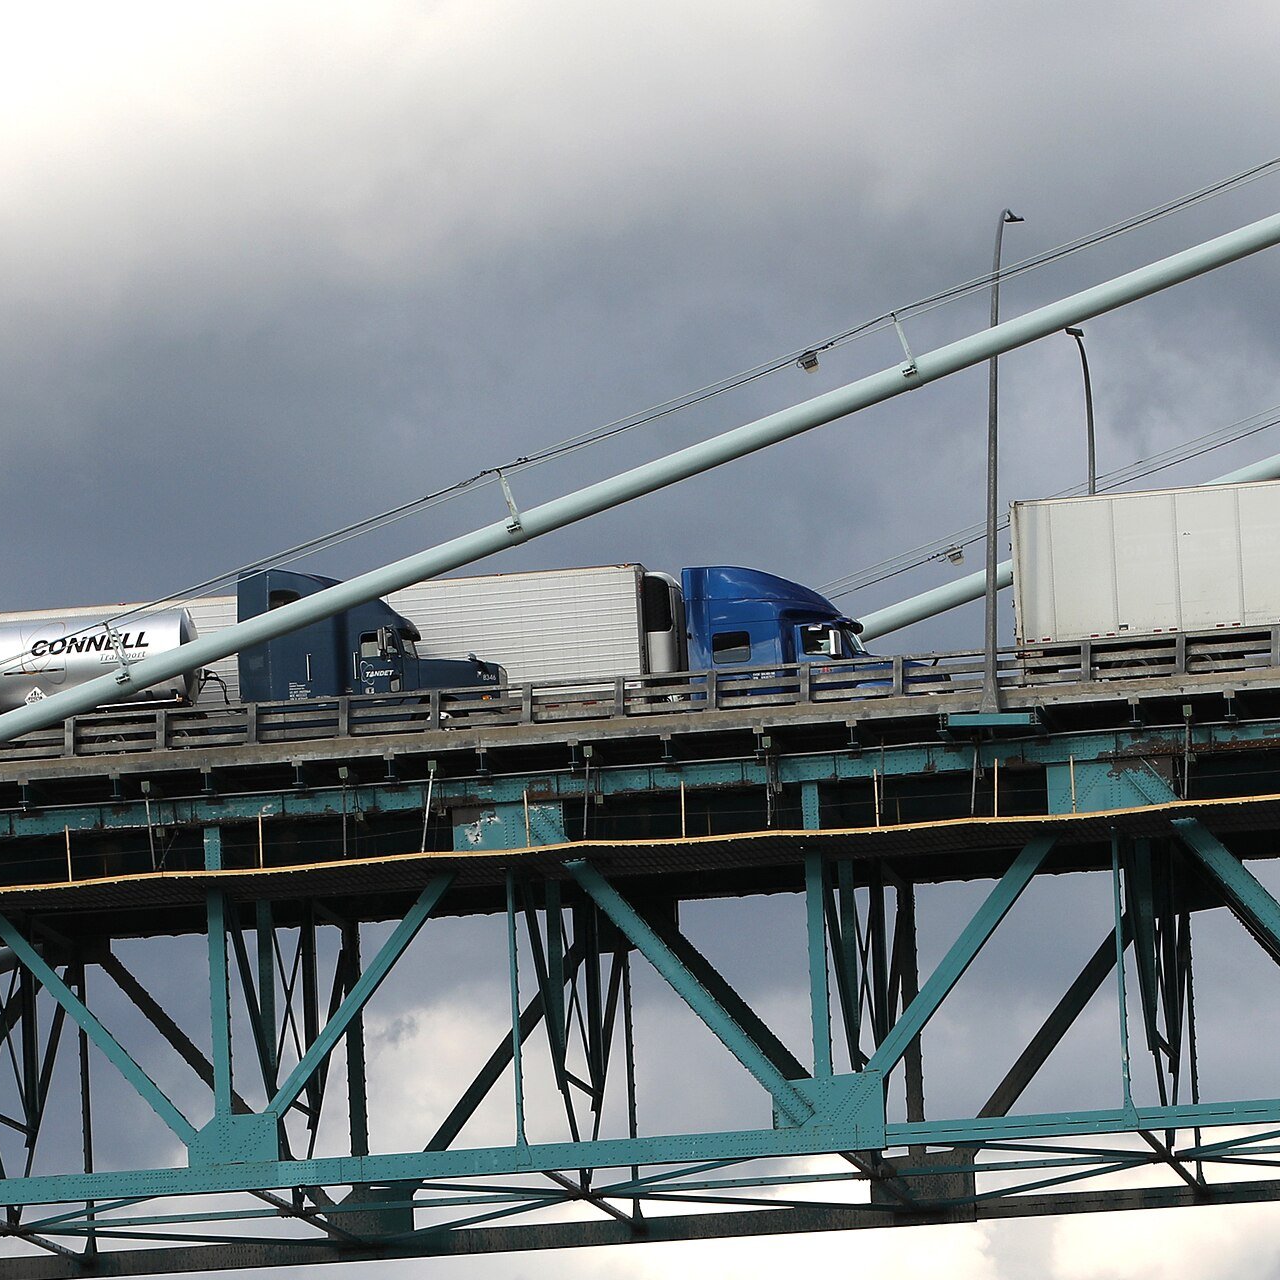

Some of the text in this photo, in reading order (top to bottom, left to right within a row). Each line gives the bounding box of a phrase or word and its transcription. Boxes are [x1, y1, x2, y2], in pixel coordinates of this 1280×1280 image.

[31, 631, 149, 656] CONNELL
[100, 651, 146, 661] Traport
[365, 669, 394, 678] TANDET
[482, 673, 497, 681] 8346
